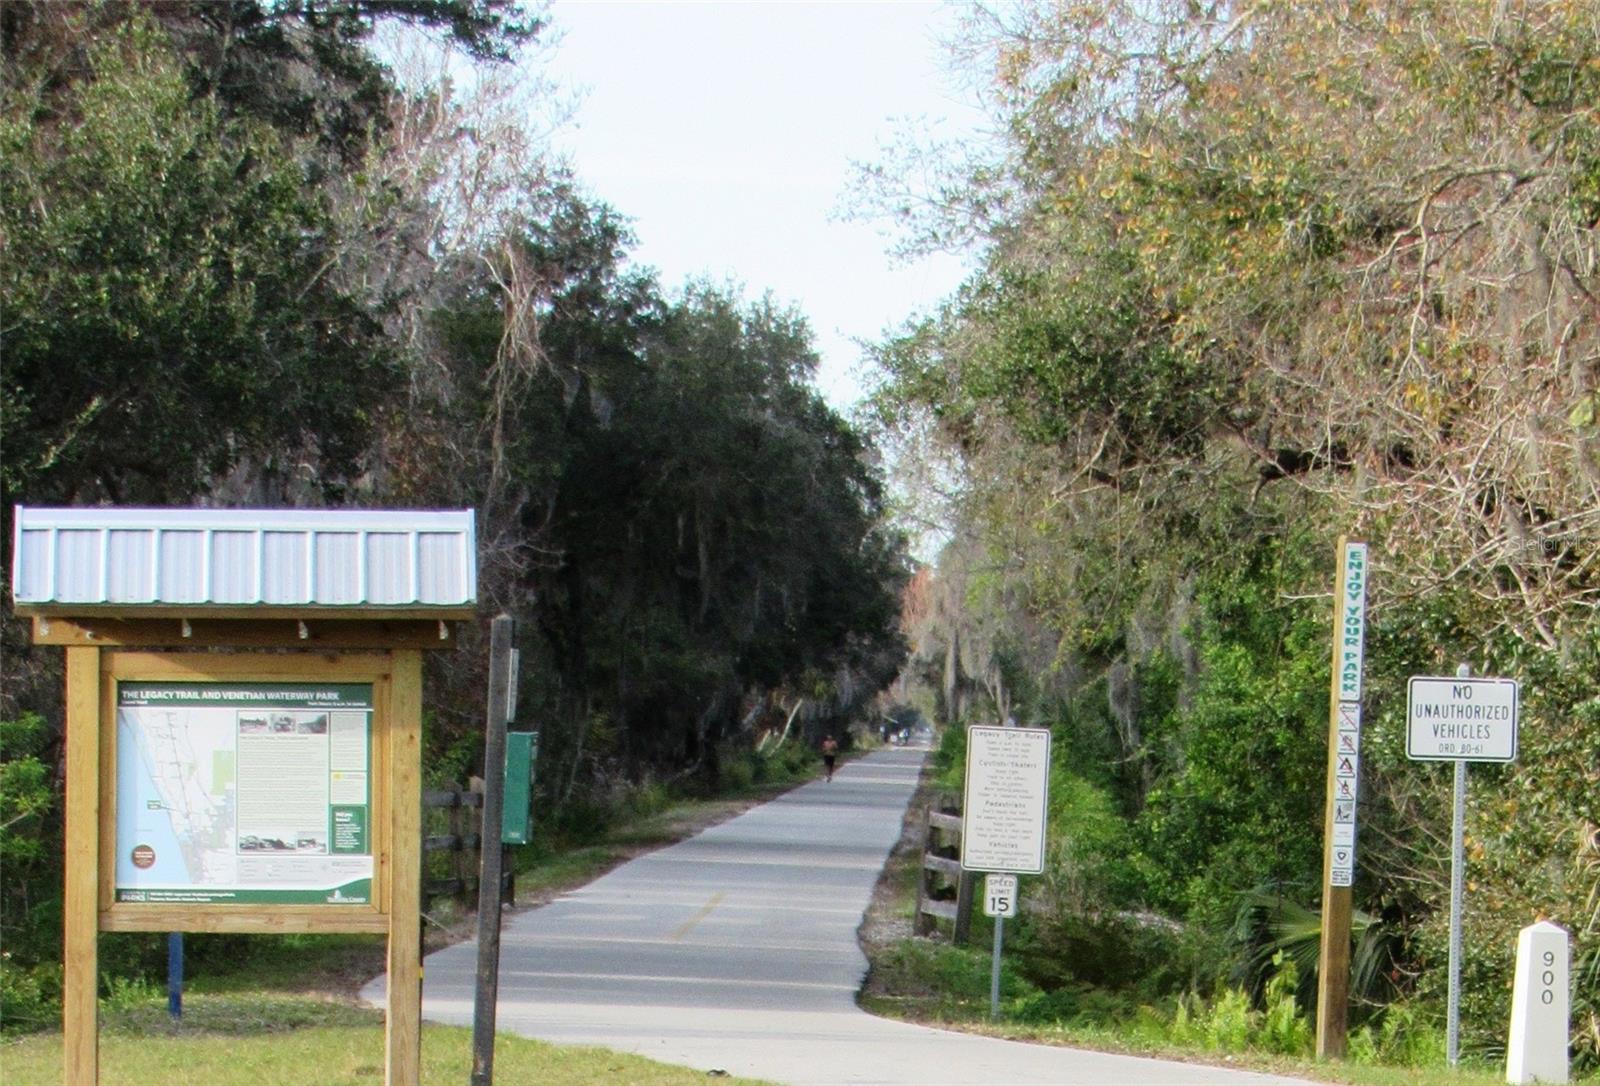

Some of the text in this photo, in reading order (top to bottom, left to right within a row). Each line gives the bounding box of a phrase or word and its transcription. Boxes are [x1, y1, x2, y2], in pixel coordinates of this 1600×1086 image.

[1346, 551, 1363, 600] ENJOY
[1344, 606, 1361, 647] YOUR
[1341, 652, 1359, 692] PARK
[122, 690, 340, 701] THE LEGACY TRAIL AND VENETIAN WATERWAY PARK
[1452, 684, 1473, 700] NO
[1415, 704, 1509, 721] UNAUTHORIZED
[1433, 724, 1491, 740] VEHICLES
[989, 879, 1014, 888] SPEED
[991, 897, 1009, 912] 15
[1541, 951, 1554, 1005] 900
